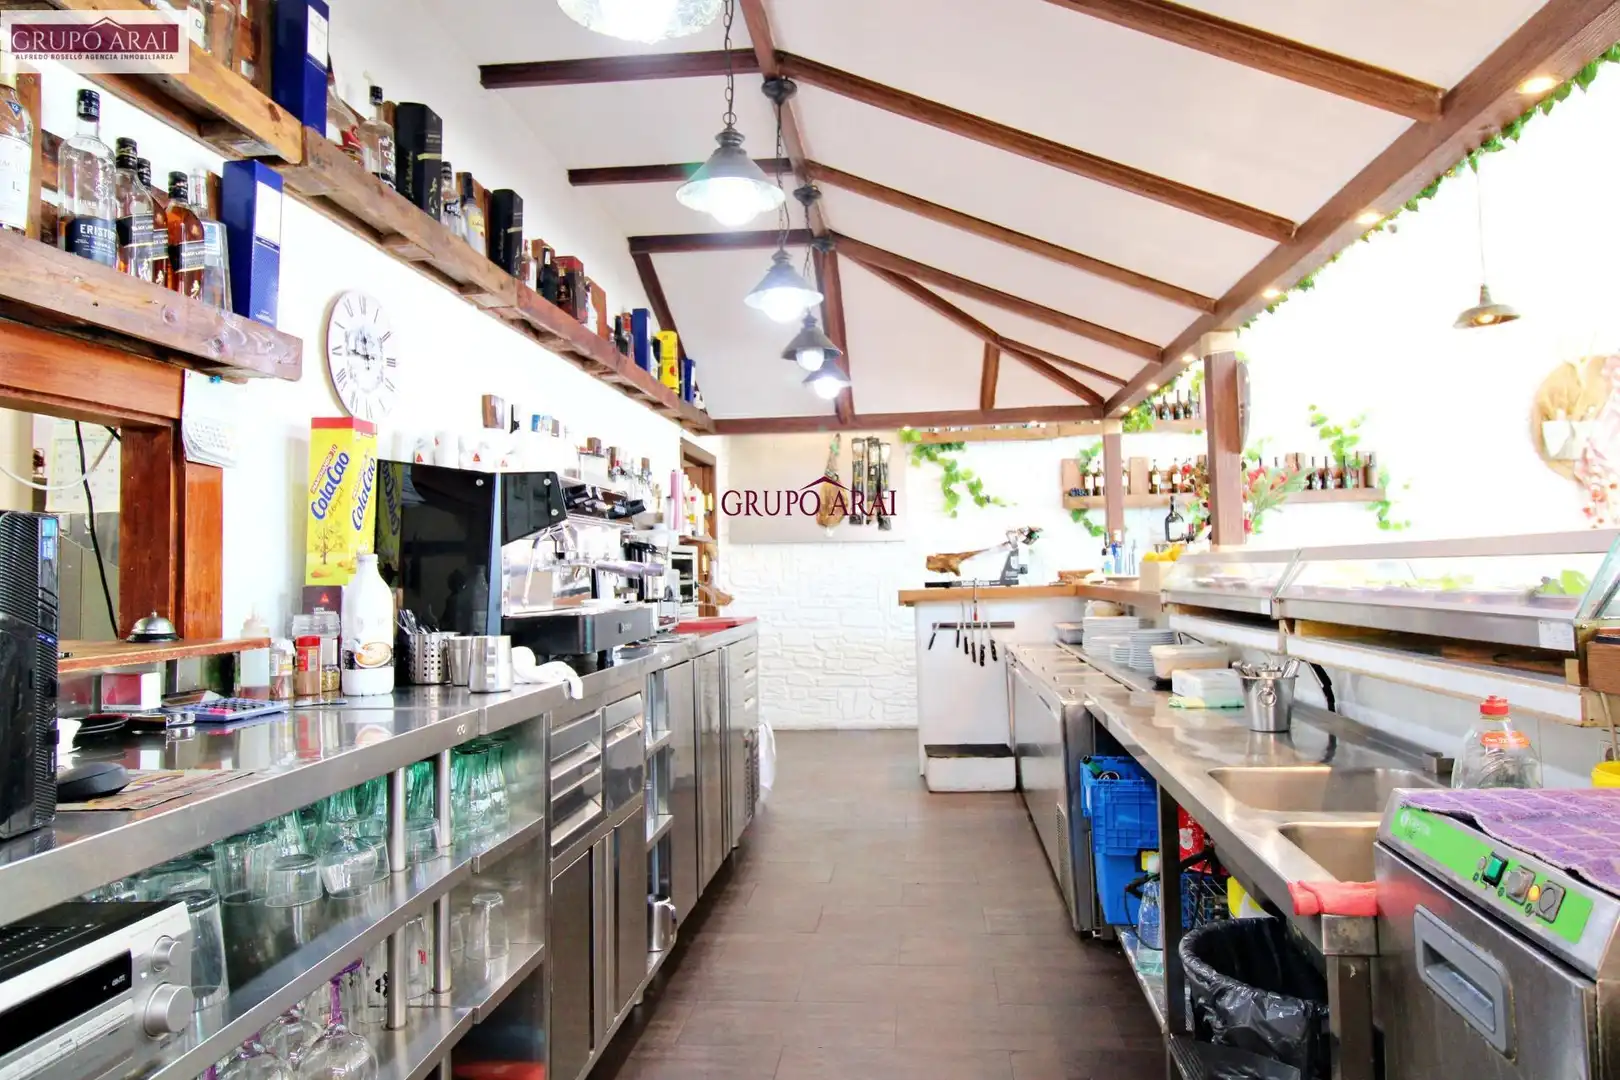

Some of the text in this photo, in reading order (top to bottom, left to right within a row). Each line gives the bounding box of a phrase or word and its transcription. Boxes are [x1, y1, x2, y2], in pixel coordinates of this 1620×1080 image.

[80, 224, 117, 242] ERISTO
[311, 451, 351, 521] ColaCao
[351, 457, 376, 531] ColaCao
